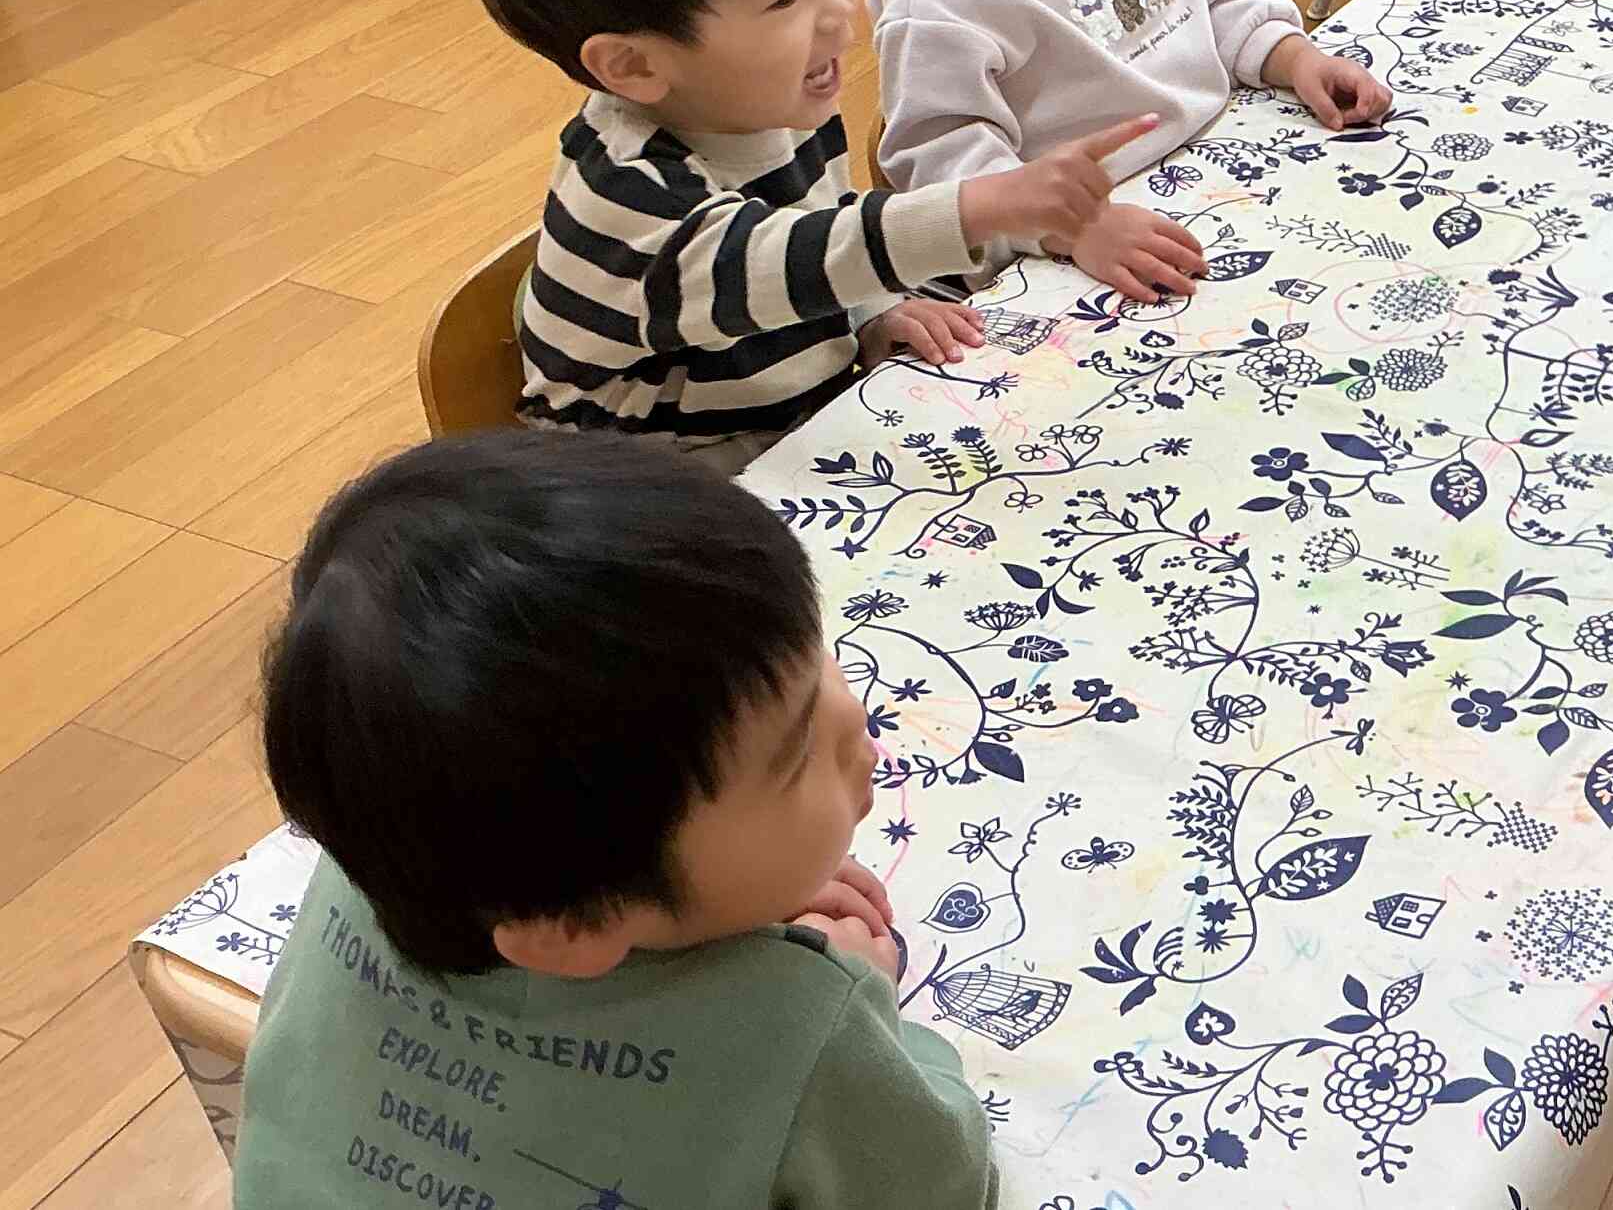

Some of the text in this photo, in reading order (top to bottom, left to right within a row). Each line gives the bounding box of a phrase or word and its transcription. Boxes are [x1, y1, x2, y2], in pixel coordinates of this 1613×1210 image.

[321, 905, 676, 1084] THOMAS & FRIENDS
[378, 1026, 505, 1113] EXPLORE.
[378, 1089, 480, 1163] DREAM.
